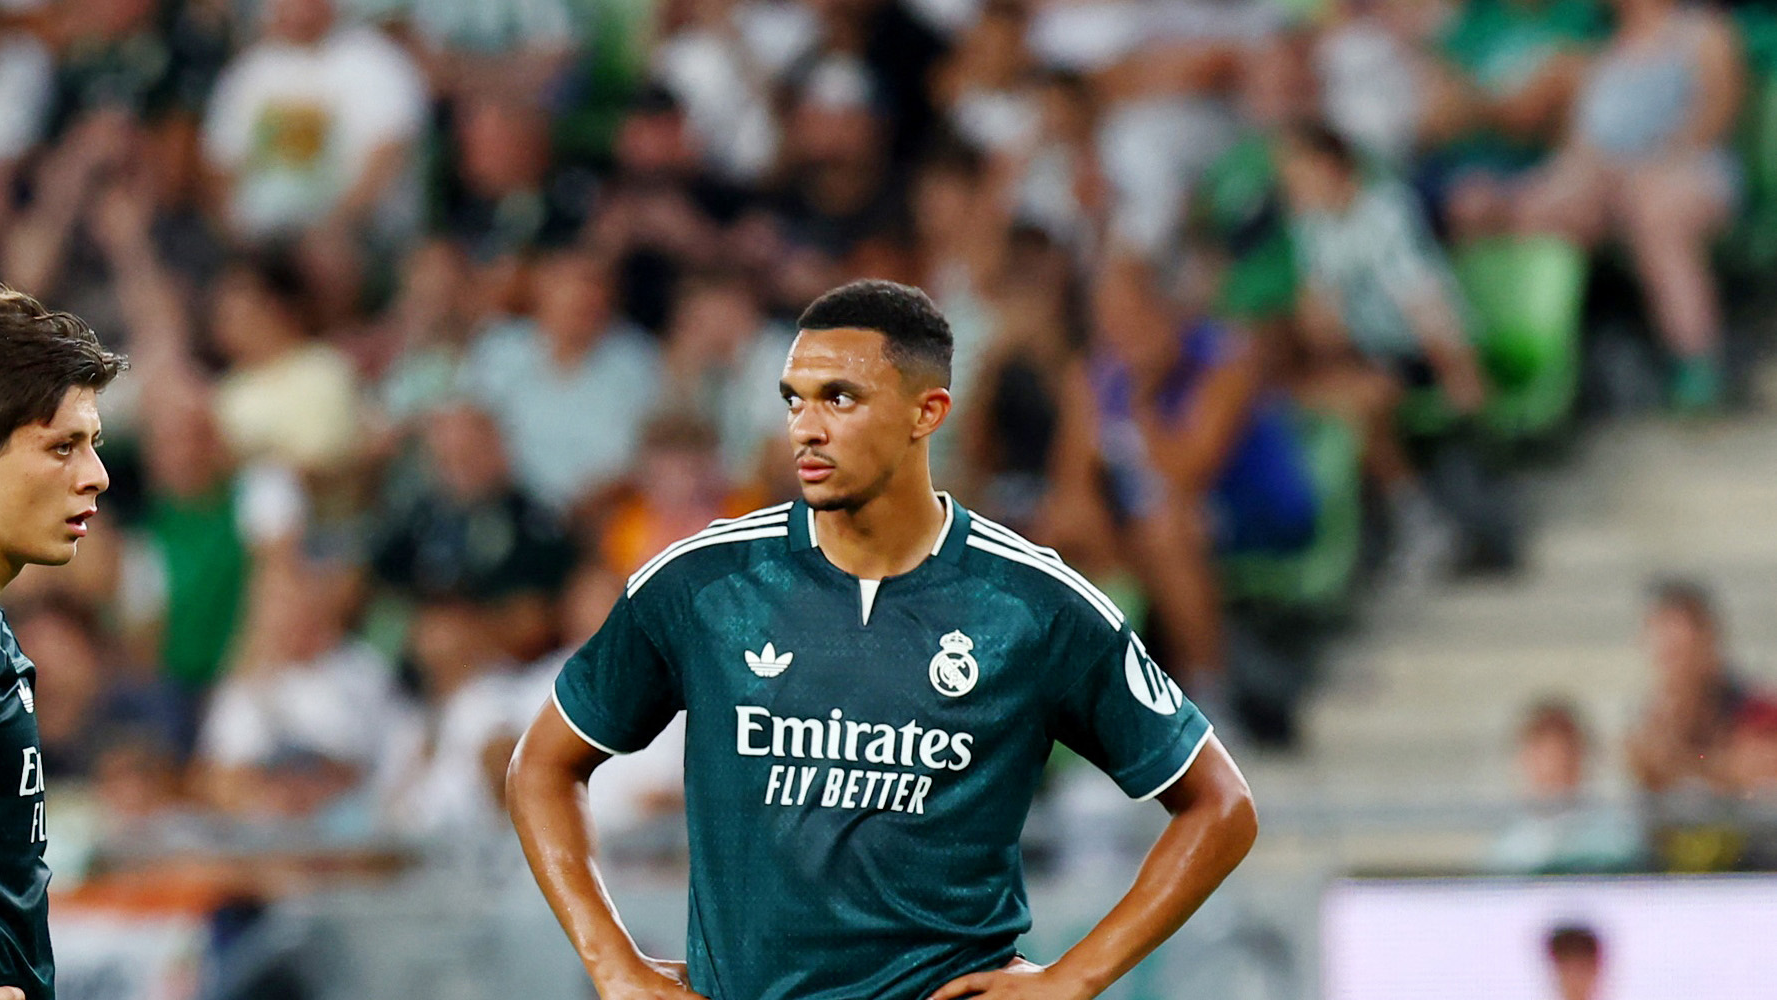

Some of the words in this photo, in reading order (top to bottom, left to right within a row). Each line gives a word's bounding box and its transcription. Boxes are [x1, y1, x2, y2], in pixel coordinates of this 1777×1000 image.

[735, 705, 973, 771] Emirates
[764, 765, 818, 806] FLY
[821, 767, 933, 814] BETTER
